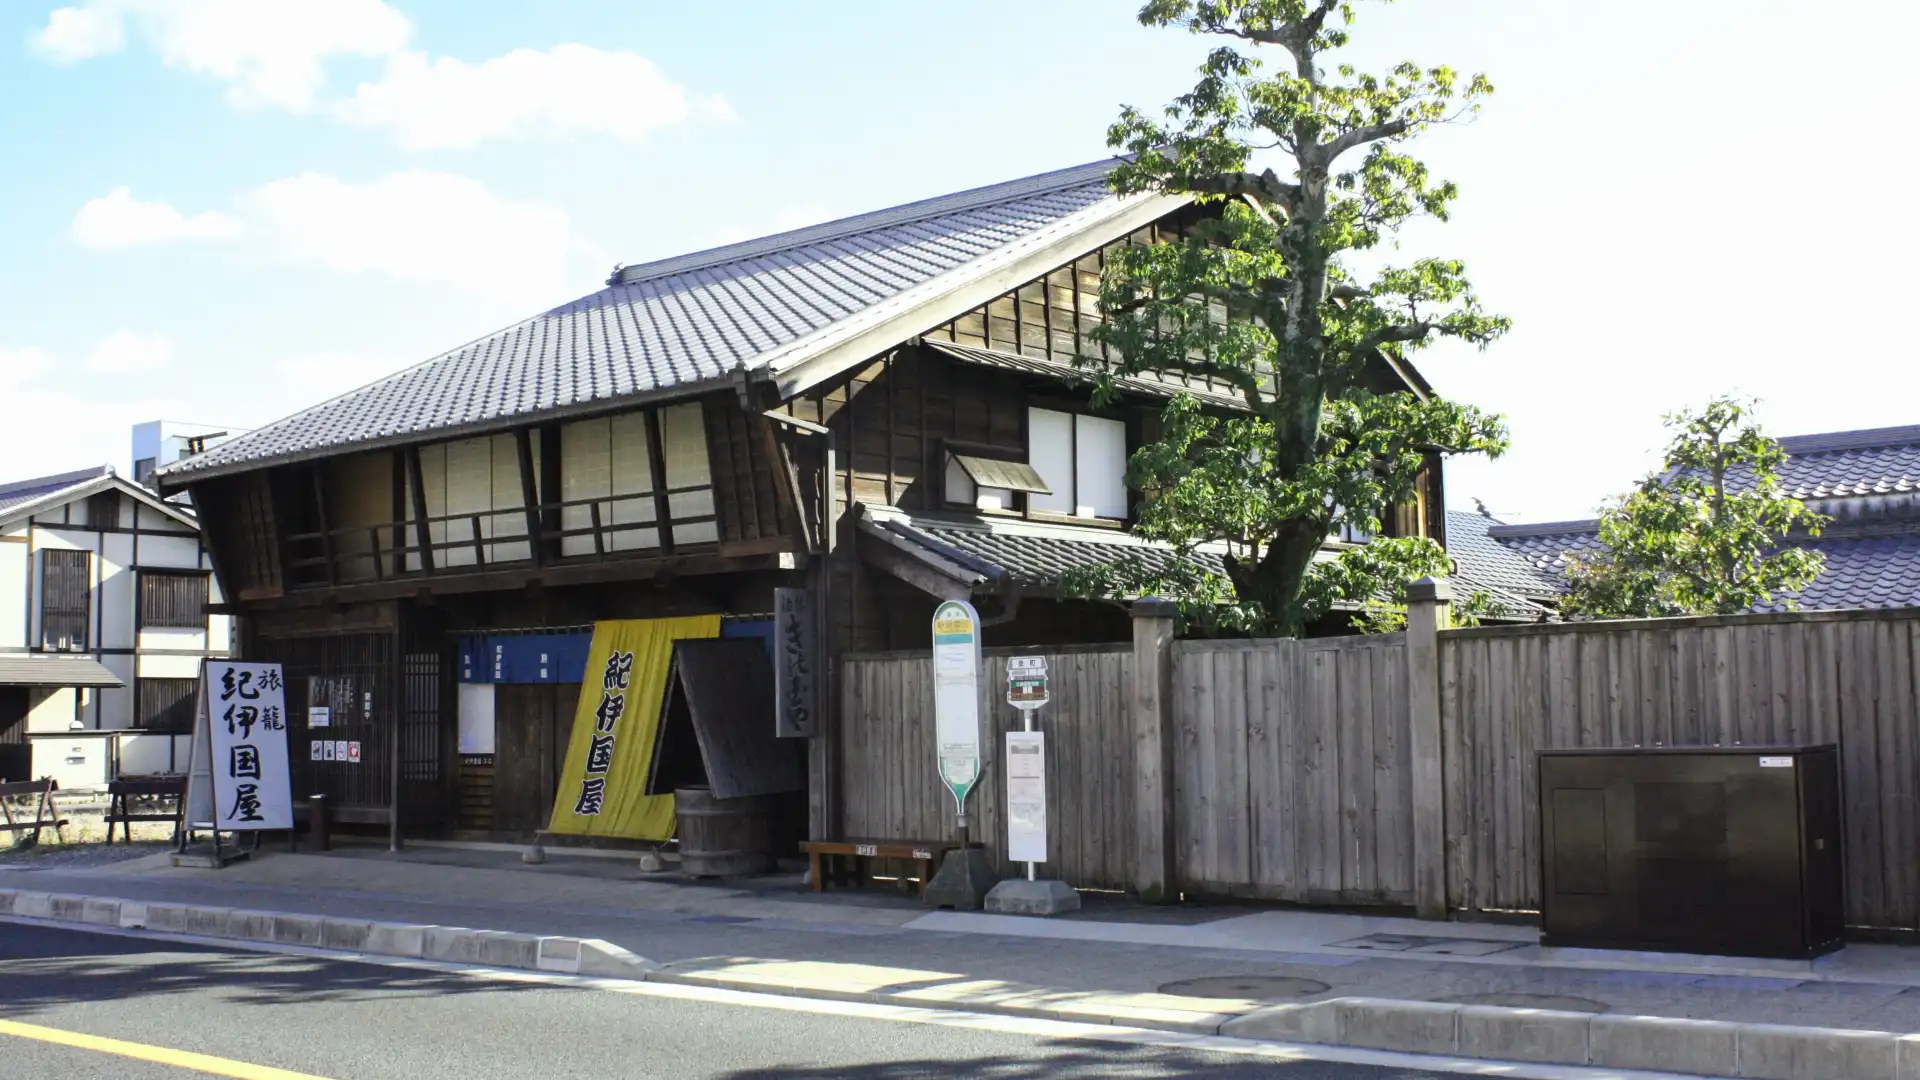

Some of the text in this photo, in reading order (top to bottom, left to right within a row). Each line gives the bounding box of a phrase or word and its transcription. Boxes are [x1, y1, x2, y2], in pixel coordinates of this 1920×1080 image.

[220, 666, 265, 822] 紀伊国屋
[257, 669, 285, 731] 旅籠
[574, 650, 635, 816] 紀伊国屋
